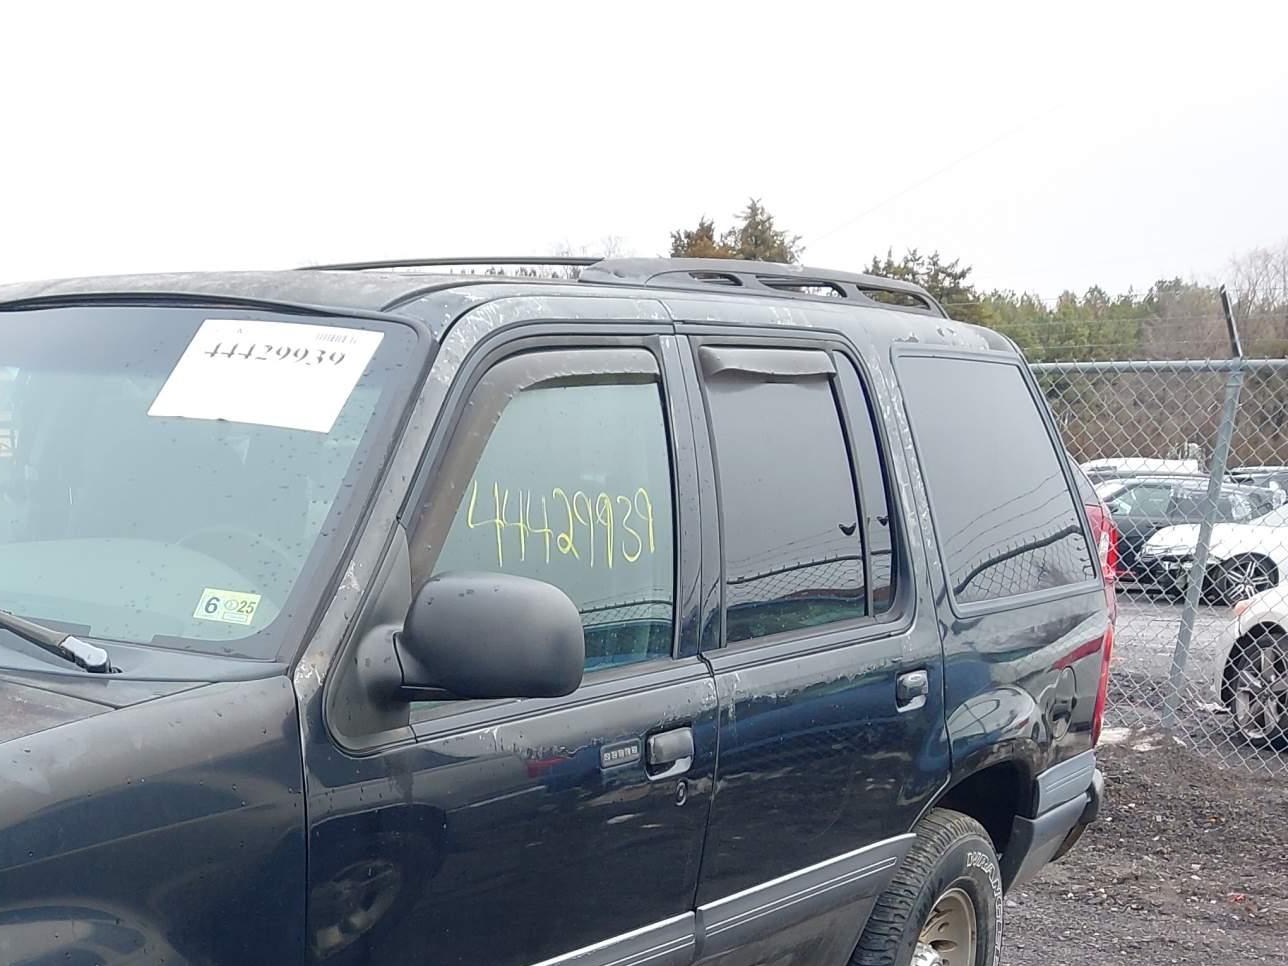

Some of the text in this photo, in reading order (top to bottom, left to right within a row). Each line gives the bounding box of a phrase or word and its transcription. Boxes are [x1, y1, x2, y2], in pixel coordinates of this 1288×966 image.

[467, 480, 655, 568] 44429939
[204, 596, 257, 614] 6 25
